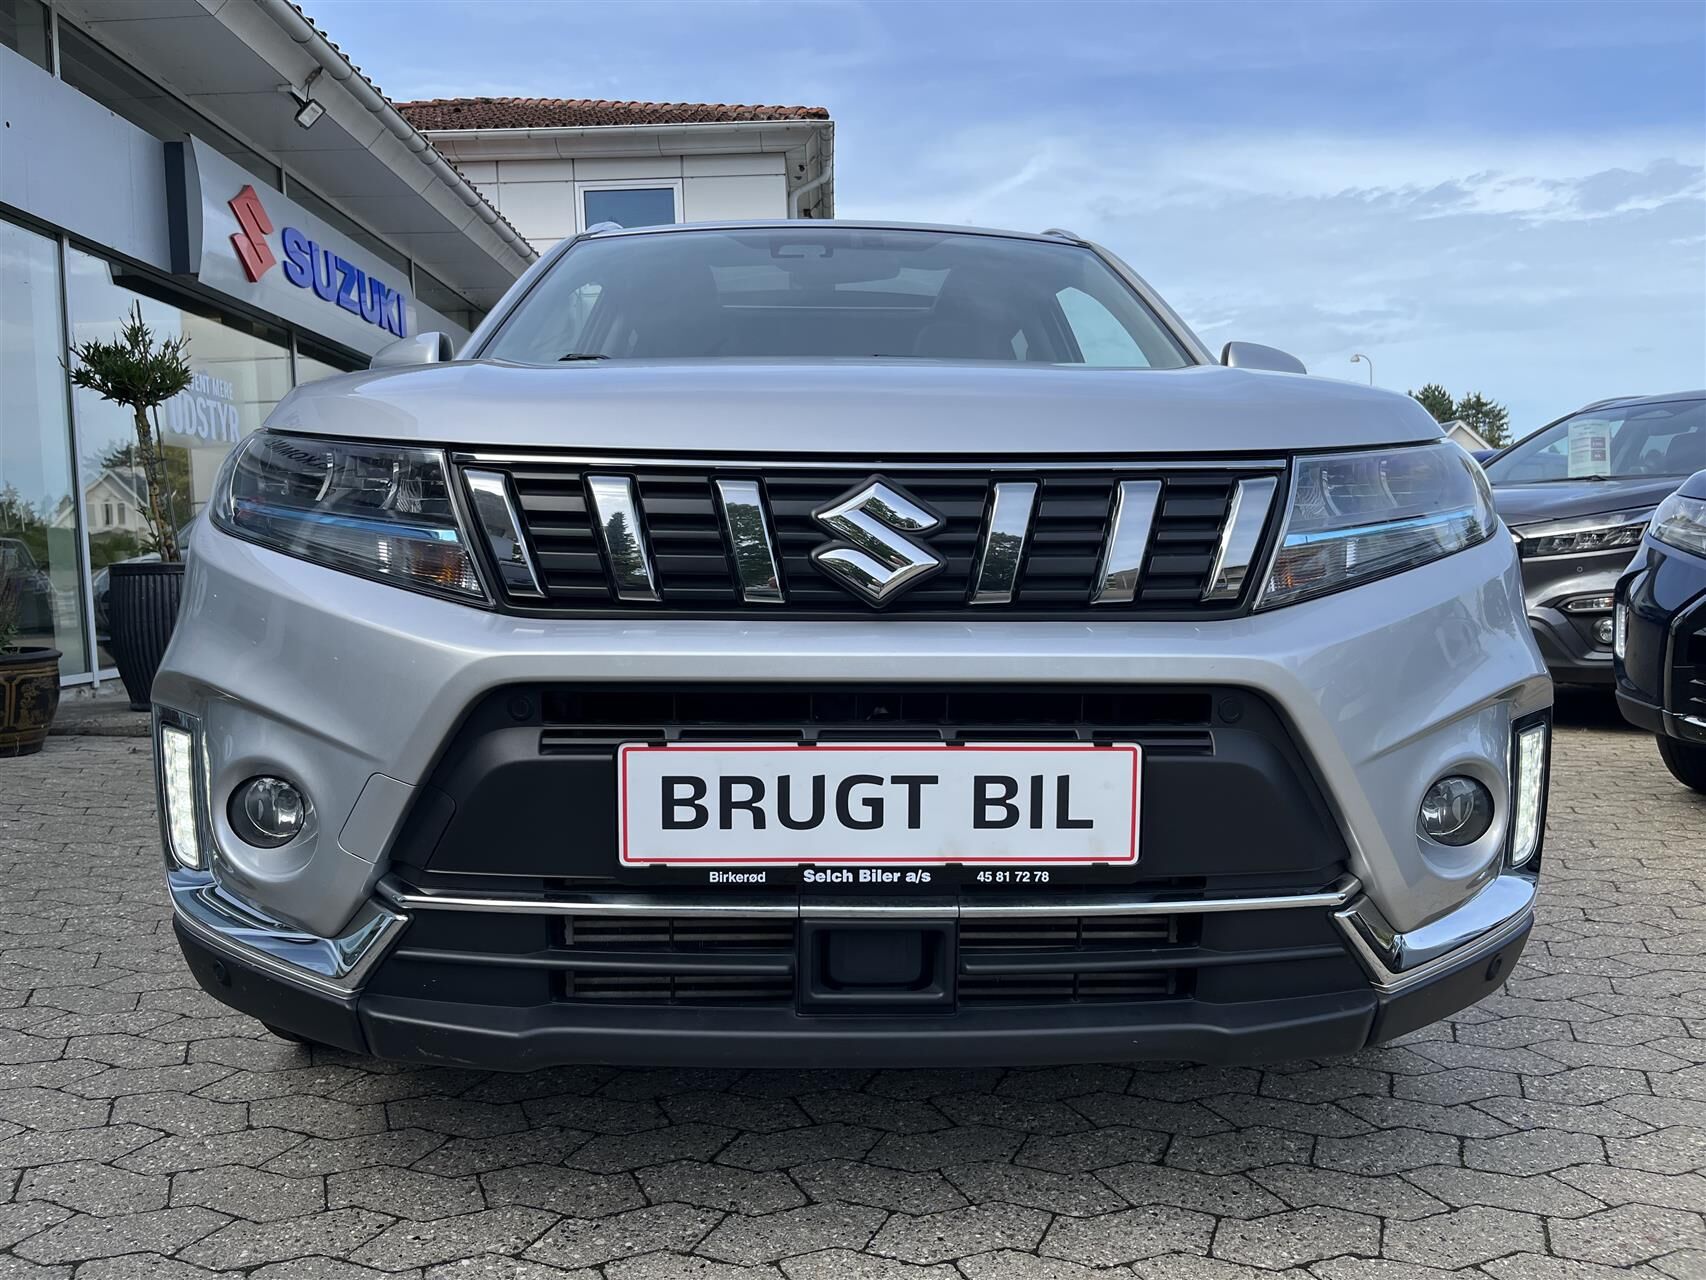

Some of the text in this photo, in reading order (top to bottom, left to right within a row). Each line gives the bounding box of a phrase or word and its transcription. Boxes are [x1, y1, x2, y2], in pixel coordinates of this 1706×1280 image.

[282, 226, 407, 339] SUZUKI
[169, 391, 241, 443] UDSTYR
[661, 774, 1094, 831] BRUGT BIL
[709, 869, 1050, 883] Birkerød Selch Biler a/s 45 81 72 78
